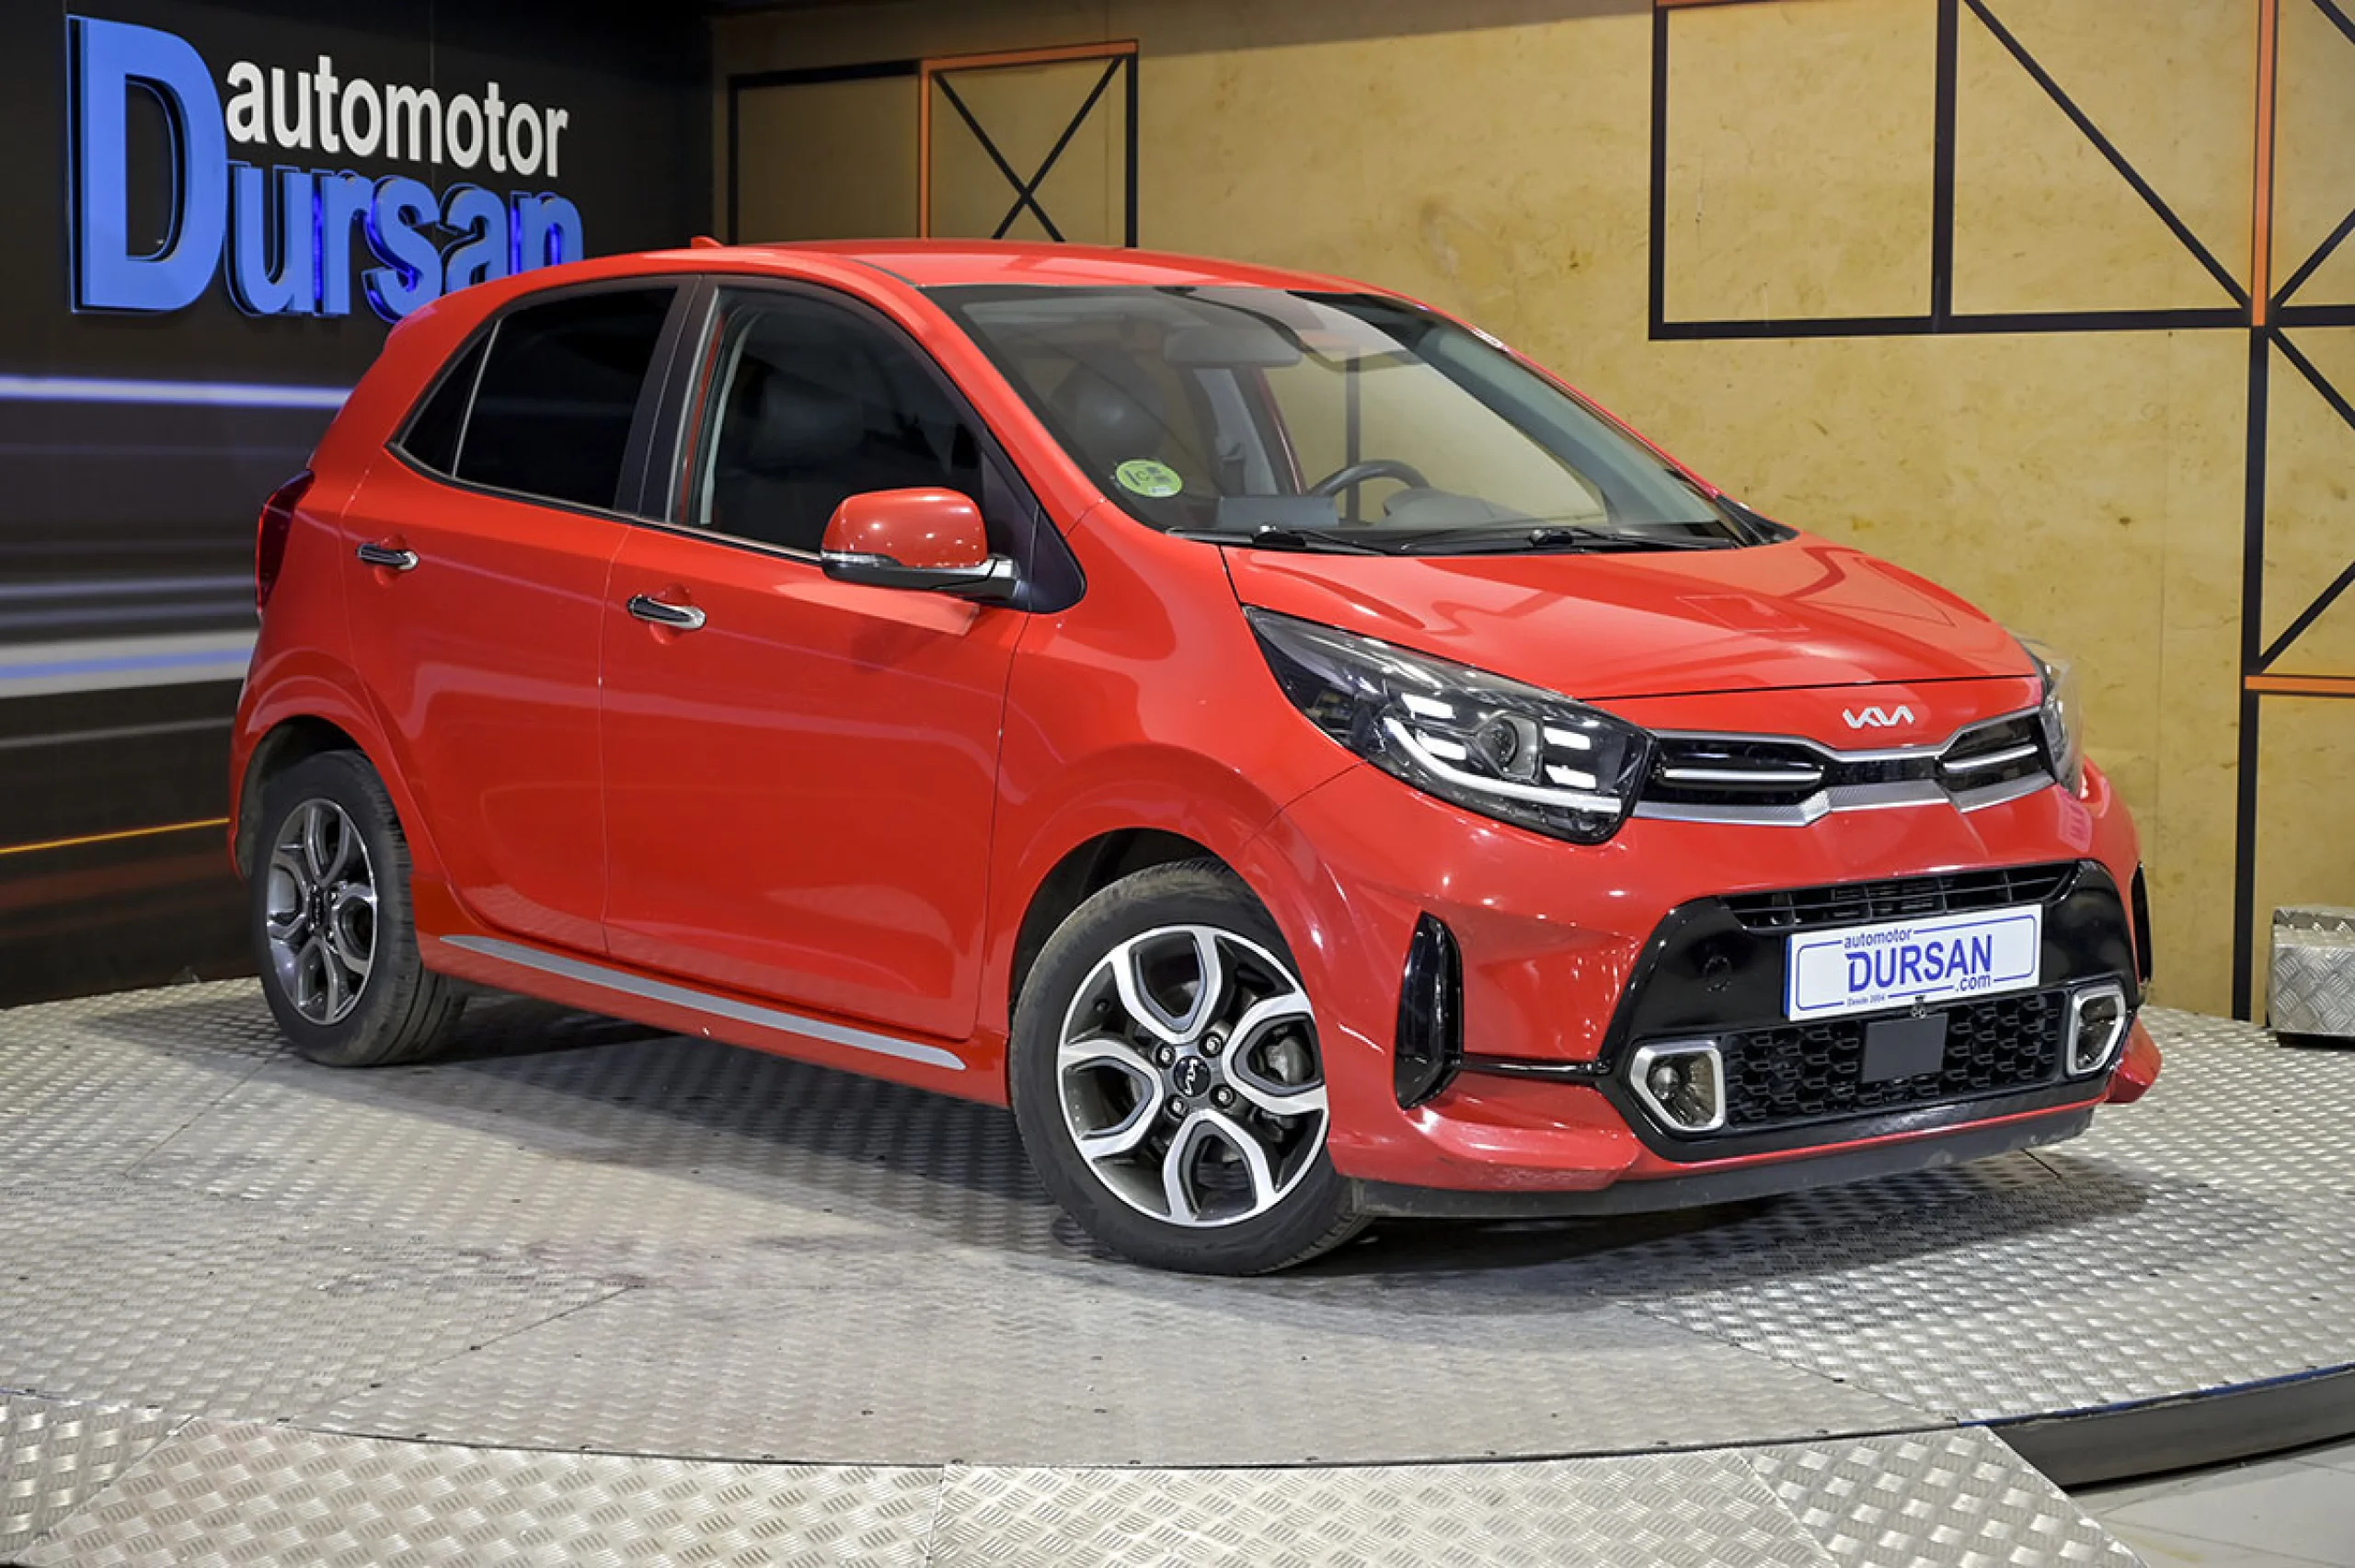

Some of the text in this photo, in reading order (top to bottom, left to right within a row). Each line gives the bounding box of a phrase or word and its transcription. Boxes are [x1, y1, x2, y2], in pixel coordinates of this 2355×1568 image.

[225, 54, 569, 177] automotor
[1842, 704, 1914, 729] KIA
[1844, 928, 1913, 949] automotor
[1844, 933, 1993, 993] DURSAN
[1954, 974, 1992, 992] .com
